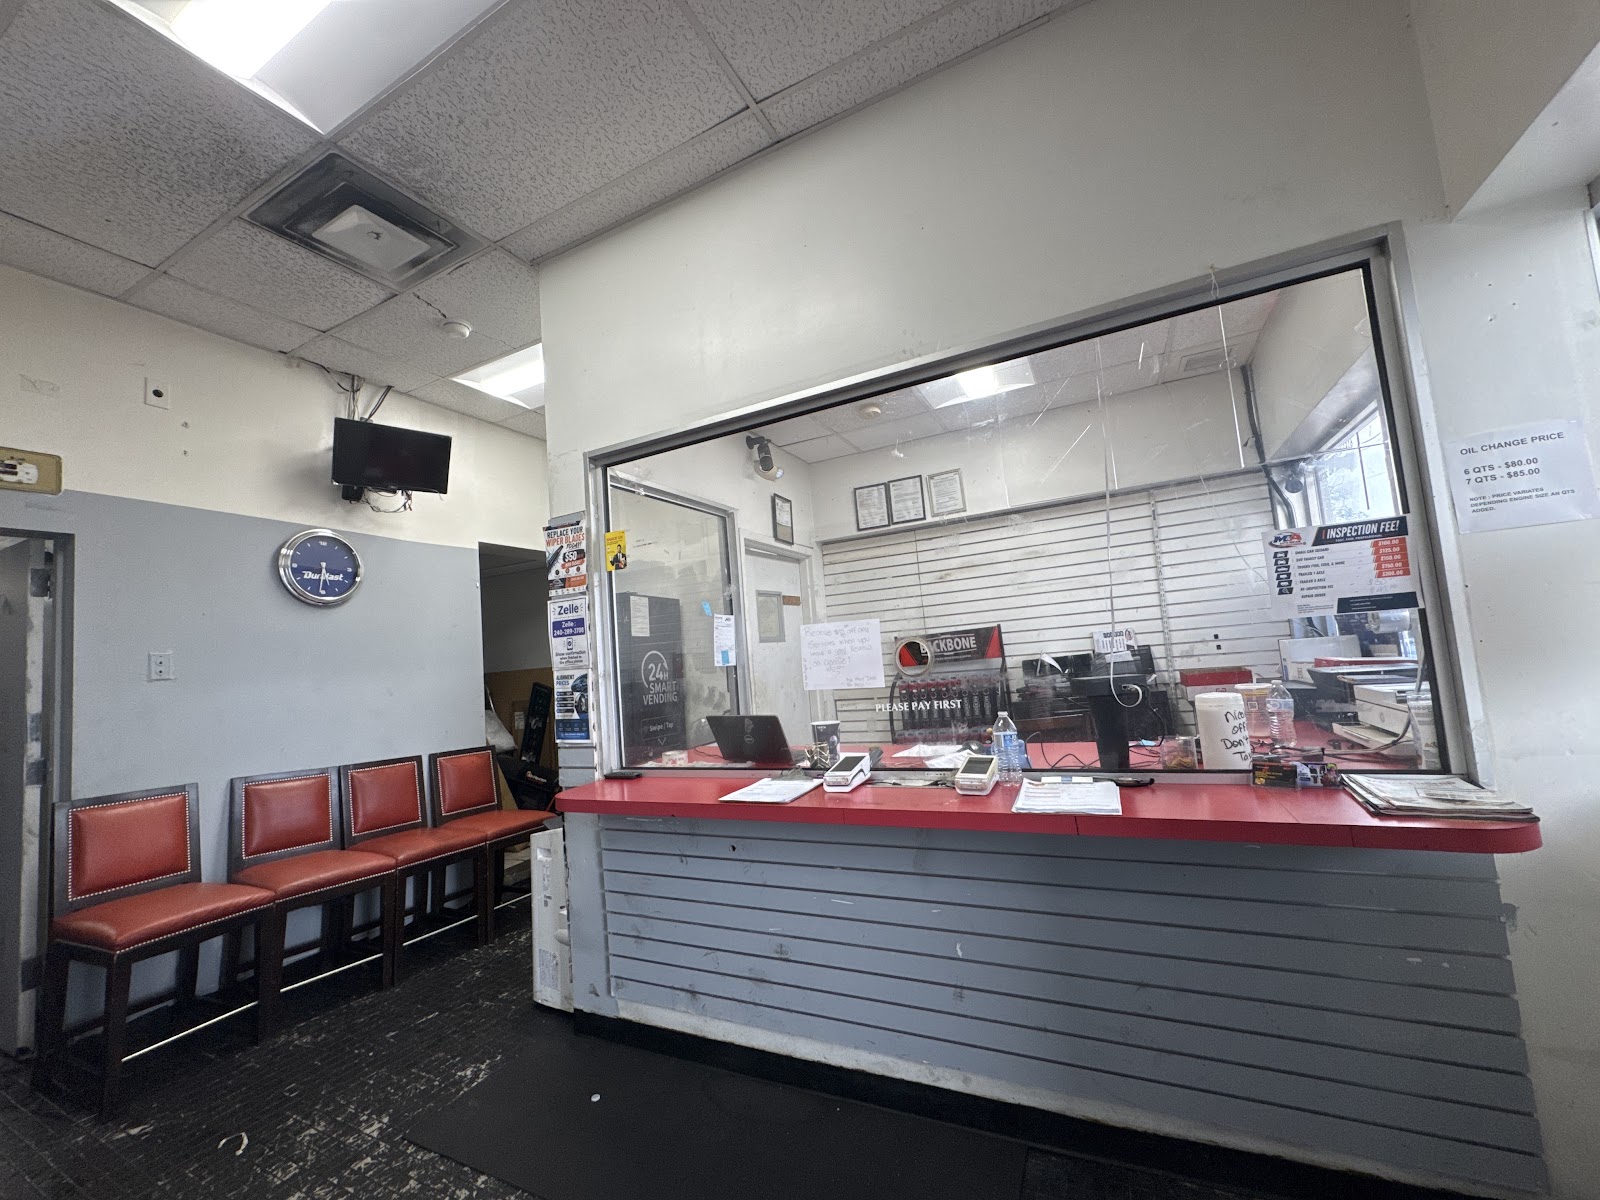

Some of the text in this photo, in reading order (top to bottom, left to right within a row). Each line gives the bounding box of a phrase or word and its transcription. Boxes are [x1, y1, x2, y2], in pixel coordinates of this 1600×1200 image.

[1481, 438, 1528, 452] CHANGE
[1531, 432, 1565, 442] PRICE
[1473, 465, 1495, 474] QTS
[1505, 457, 1538, 469] $80.00
[1475, 474, 1497, 483] QTS
[1507, 467, 1540, 479] $85.00
[1513, 487, 1544, 495] VARIATES
[1471, 499, 1507, 508] DEPENDING
[547, 526, 583, 538] REPLACE YOUR
[1327, 520, 1399, 539] INSPECTION FEE!
[546, 533, 584, 547] WIPER BLADES
[558, 604, 579, 615] Zelle
[650, 681, 676, 694] SMART
[643, 692, 677, 705] VENDING
[875, 702, 909, 712] PLEASE
[911, 701, 931, 710] PAY
[934, 700, 962, 709] FIRST
